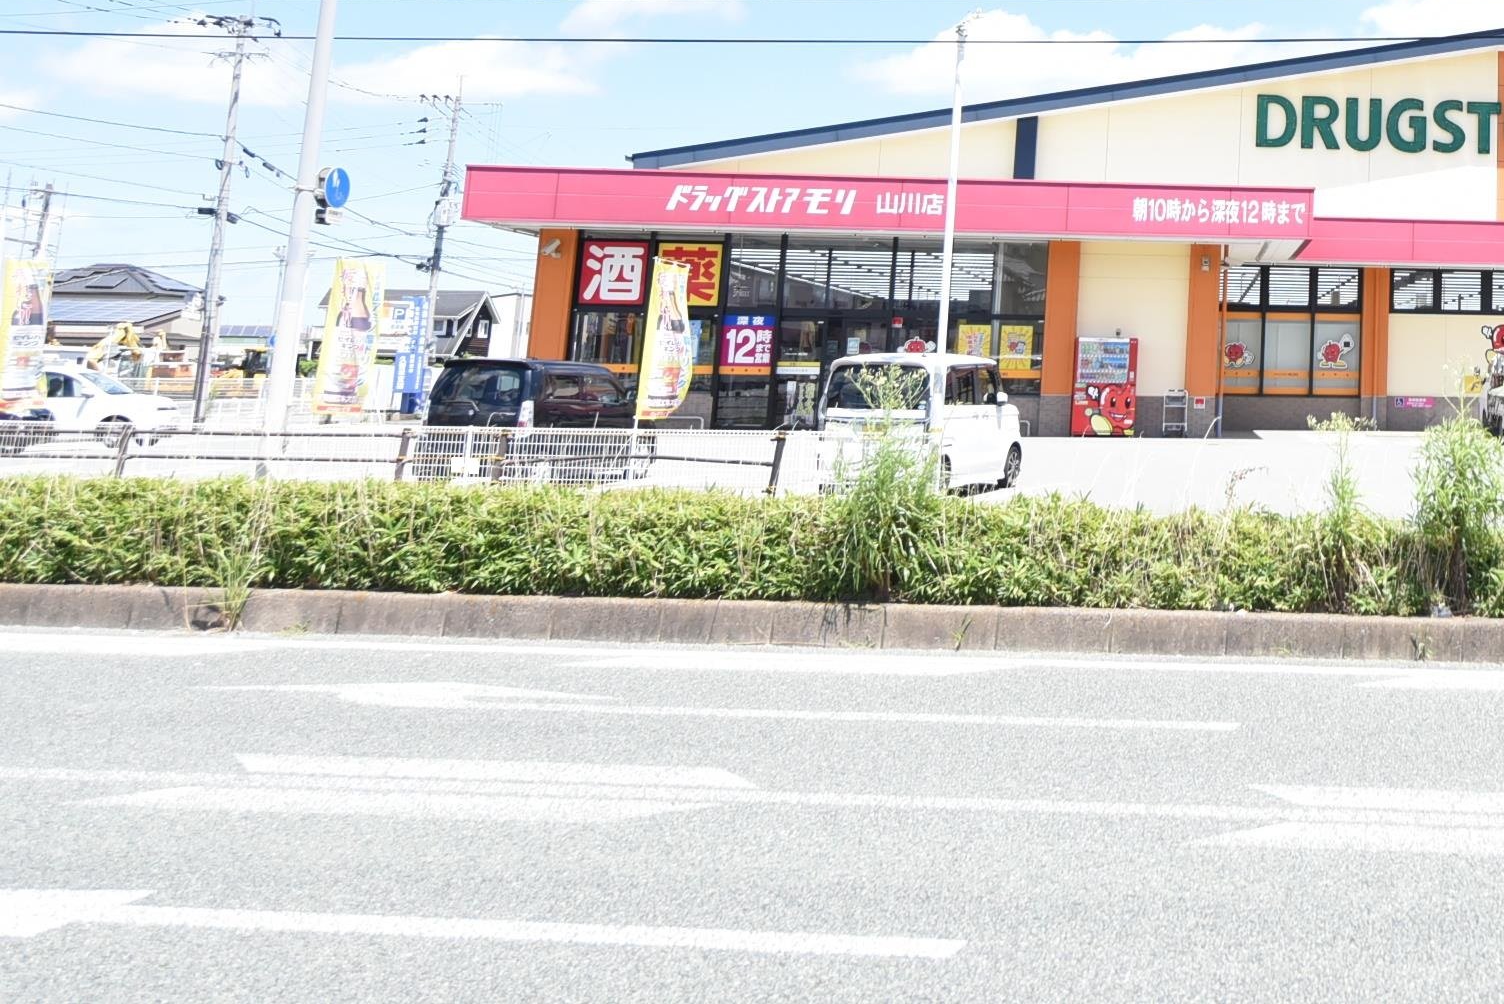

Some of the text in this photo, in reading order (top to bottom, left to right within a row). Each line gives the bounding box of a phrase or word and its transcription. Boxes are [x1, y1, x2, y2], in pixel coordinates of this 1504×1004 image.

[876, 192, 944, 216] 山川店
[1132, 197, 1307, 225] 朝10時から深夜12時まで
[583, 244, 646, 302] 酒
[662, 246, 719, 302] 薬
[394, 308, 405, 319] P
[736, 315, 765, 326] 深夜
[726, 328, 757, 364] 12
